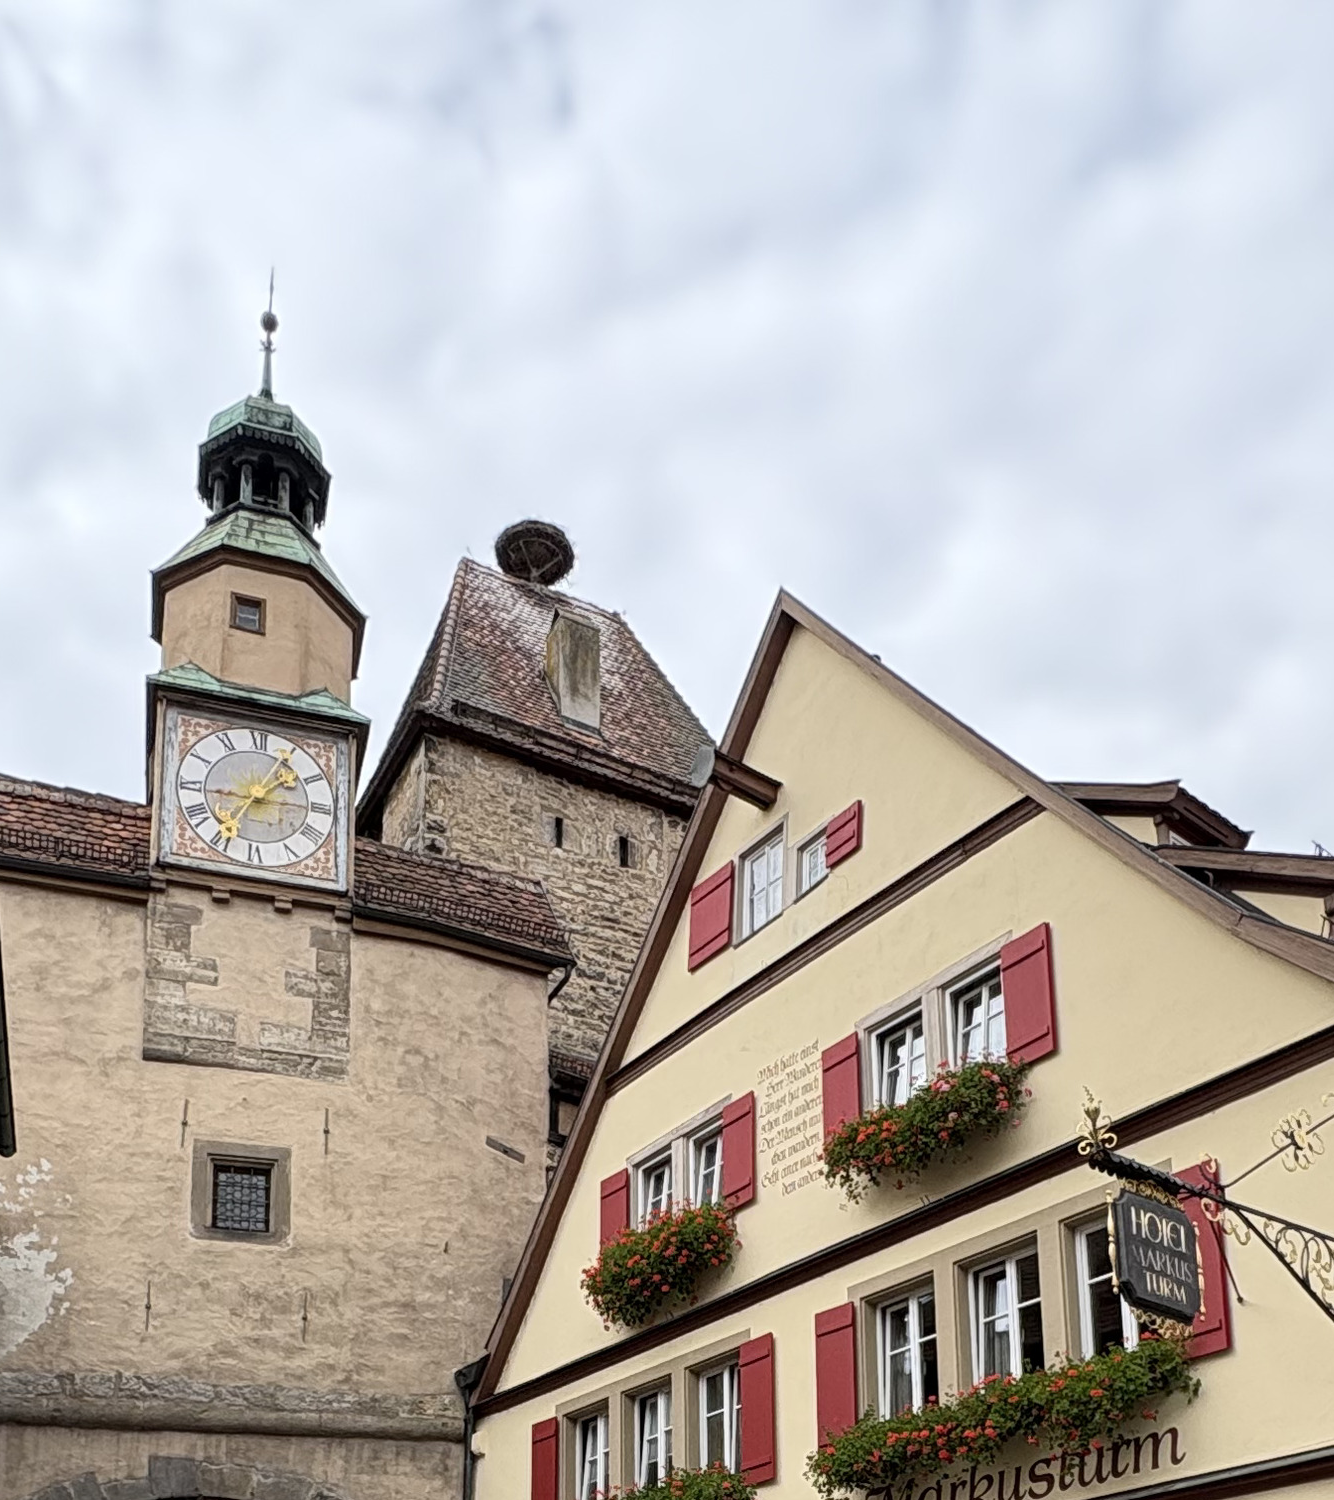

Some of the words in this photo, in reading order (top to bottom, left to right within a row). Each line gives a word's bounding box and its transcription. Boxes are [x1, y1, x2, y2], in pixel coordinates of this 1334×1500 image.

[215, 732, 236, 752] XI
[250, 730, 269, 747] XII
[1130, 1206, 1188, 1254] HOTEL
[1132, 1244, 1193, 1284] MARKUS
[1143, 1271, 1187, 1305] TURM
